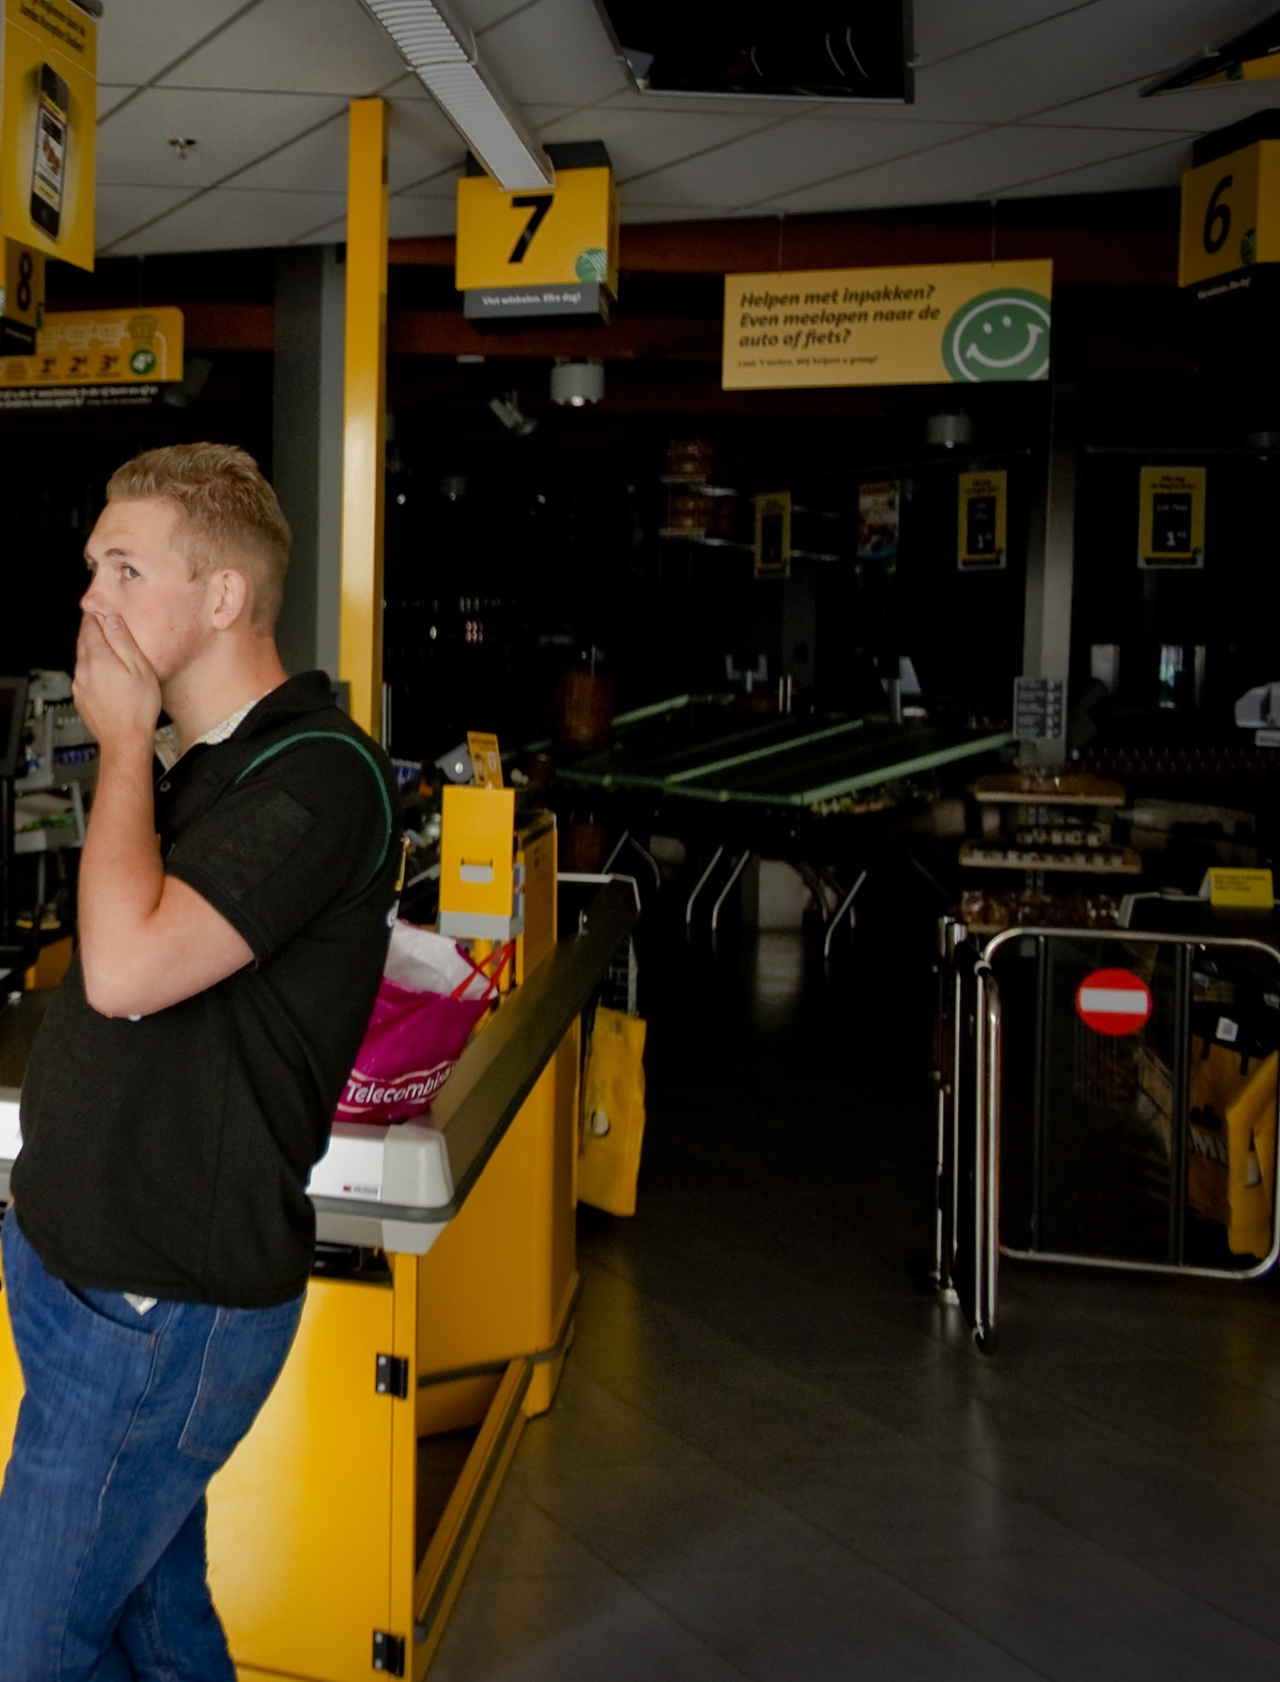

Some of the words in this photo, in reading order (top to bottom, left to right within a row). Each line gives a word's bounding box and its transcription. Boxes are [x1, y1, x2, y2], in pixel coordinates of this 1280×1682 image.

[509, 195, 554, 264] 7
[1203, 174, 1234, 255] 6
[17, 251, 33, 312] 8
[740, 290, 800, 312] Helpen
[804, 288, 839, 306] met
[843, 283, 936, 308] inpakken?
[739, 332, 780, 348] auto
[783, 328, 803, 351] of
[801, 327, 852, 351] fiets?
[740, 311, 780, 329] Even
[782, 307, 869, 330] meelopen
[872, 308, 916, 323] naar
[918, 303, 940, 321] de
